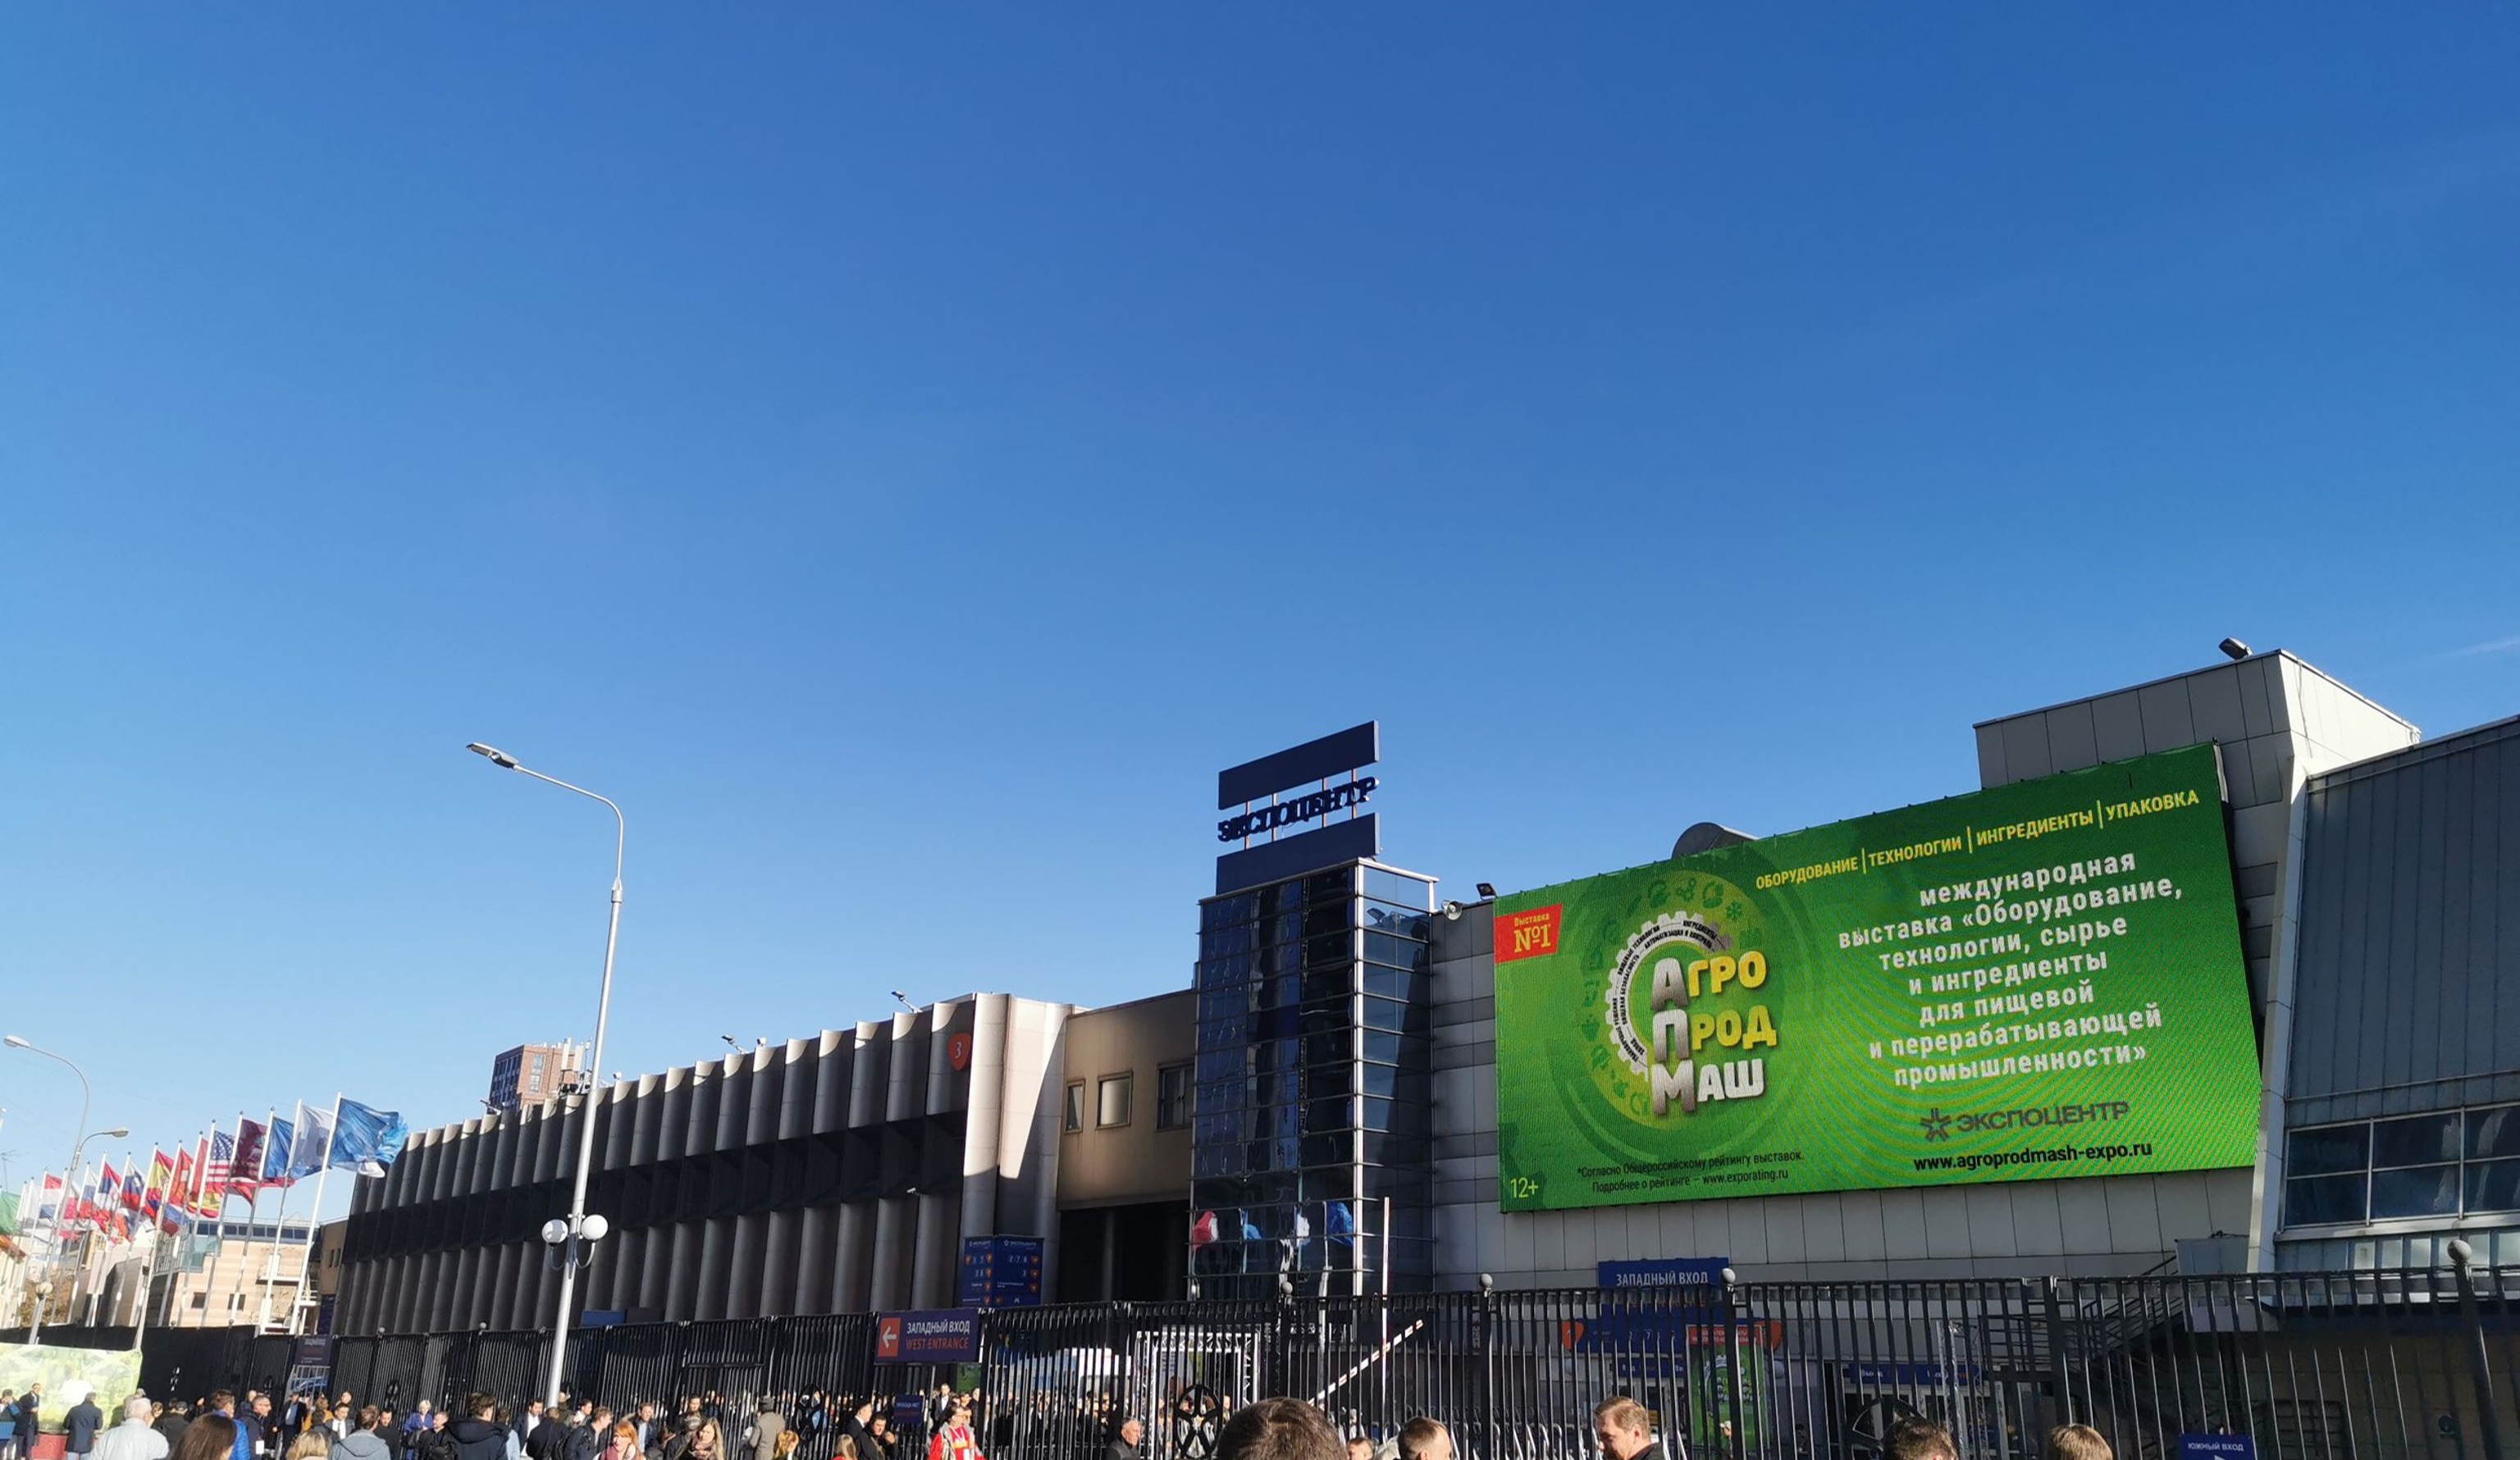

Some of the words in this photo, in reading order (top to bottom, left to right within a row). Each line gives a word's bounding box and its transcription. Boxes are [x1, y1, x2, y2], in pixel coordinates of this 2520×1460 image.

[1217, 777, 1379, 842] ЭКСПОЦЕНТР
[1756, 857, 1858, 889] ОБОРУДОВАНИЕ
[1869, 836, 1961, 867] ТЕХНОЛОГИИ
[1976, 810, 2093, 846] ИНГРЕДИЕНТЫ
[2105, 789, 2199, 820] УПАКОВКА
[1920, 853, 2135, 906] международная
[1514, 913, 1550, 927] Выставка
[1839, 915, 1952, 949] выставка
[1879, 933, 2030, 970] технологии,
[2040, 917, 2127, 947] сырье
[1909, 979, 1922, 996] и
[1931, 951, 2107, 992] ингредиенты
[1920, 1001, 1965, 1028] для
[1974, 979, 2093, 1016] пищевой
[1869, 1041, 1883, 1059] и
[1892, 1001, 2162, 1059] перерабатывающей
[1894, 1044, 2147, 1090] промышленности»
[1956, 1101, 2130, 1132] ЭКСПОЦЕНТР
[1623, 1158, 1706, 1175] Общероссийскому
[1709, 1155, 1751, 1169] рейтингу
[1913, 1143, 2153, 1170] www.agroprodmash-expo.ru
[1510, 1177, 1539, 1199] 12+
[1592, 1179, 1640, 1193] Подробнее
[1650, 1176, 1690, 1190] рейтинге
[1702, 1170, 1788, 1184] www.exporating.ru
[1616, 1271, 1676, 1286] ЗАПАДНЫЙ
[1679, 1271, 1709, 1284] ВХОД
[906, 1319, 947, 1335] ЗАПАДНЫЙ
[949, 1321, 970, 1335] ВХОД
[906, 1339, 925, 1349] WEST
[928, 1338, 969, 1349] ENTRANCE
[2188, 1442, 2220, 1450] ЮЖНЫЙ
[2221, 1443, 2244, 1452] ВХОД
